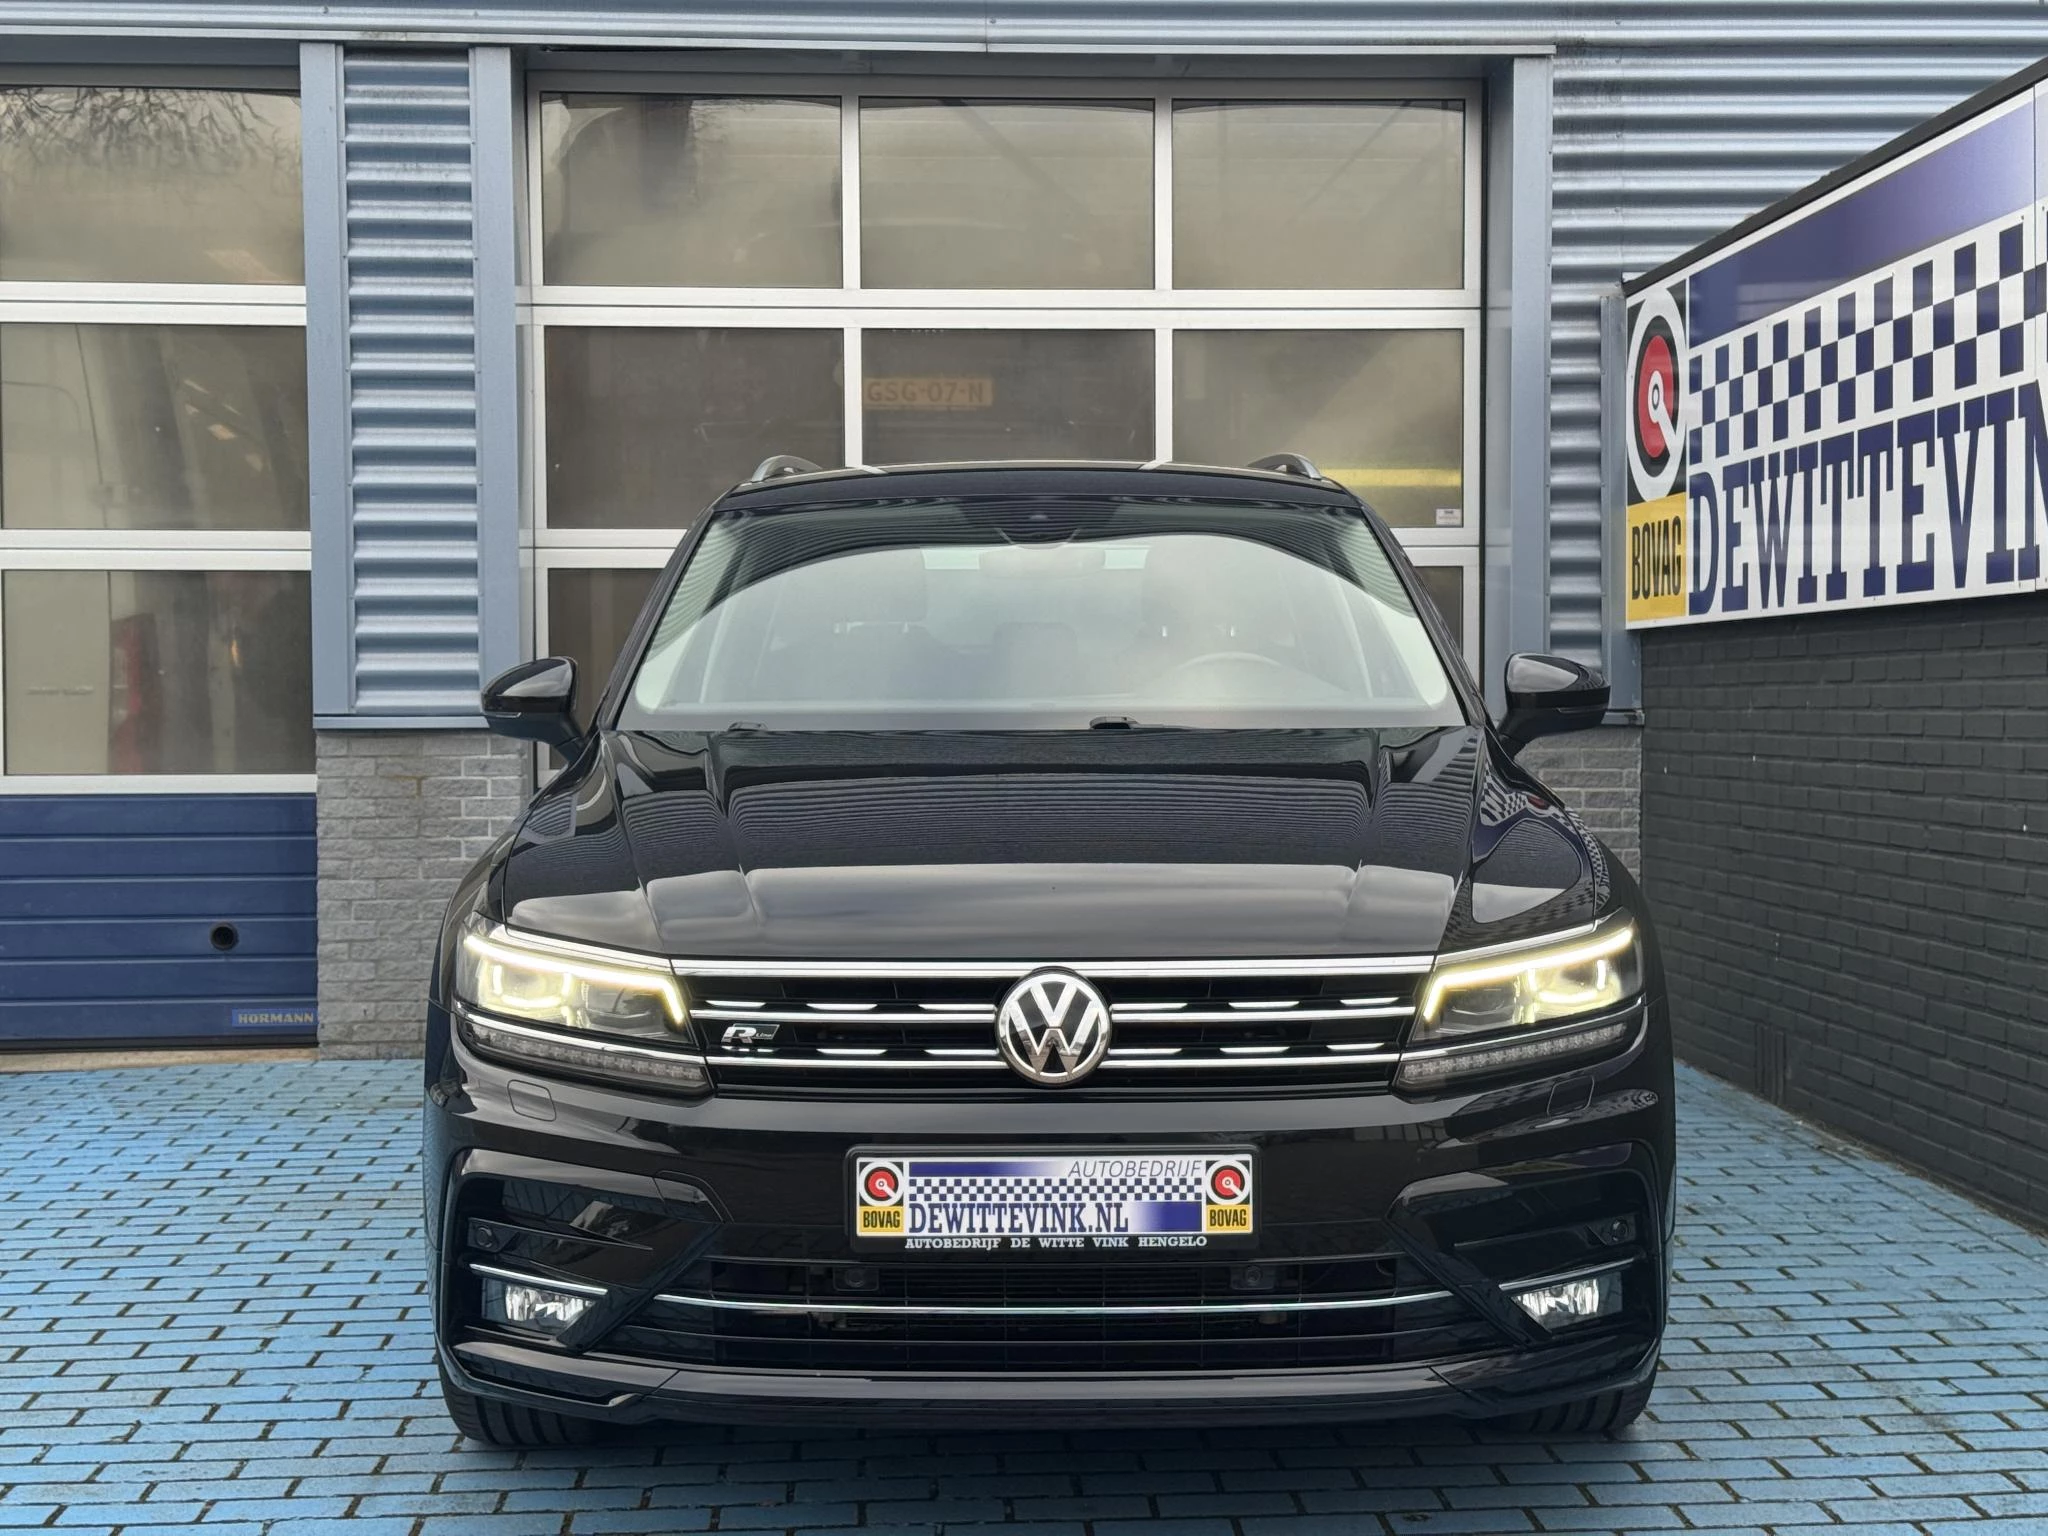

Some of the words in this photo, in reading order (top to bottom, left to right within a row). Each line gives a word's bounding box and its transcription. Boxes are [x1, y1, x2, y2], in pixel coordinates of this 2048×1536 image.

[1632, 515, 1683, 600] BOVAG
[1068, 1160, 1202, 1178] AUTOBEDRIJF
[863, 1211, 900, 1229] BOVAG
[909, 1202, 1129, 1233] DEWITTEVINK.NL
[1209, 1209, 1247, 1227] BOVAG
[905, 1237, 1001, 1250] AUTOBEDRIJF
[1010, 1238, 1030, 1248] DE
[1038, 1237, 1084, 1248] WITTE
[1092, 1236, 1129, 1248] VINK
[1138, 1235, 1207, 1247] HENGELO
